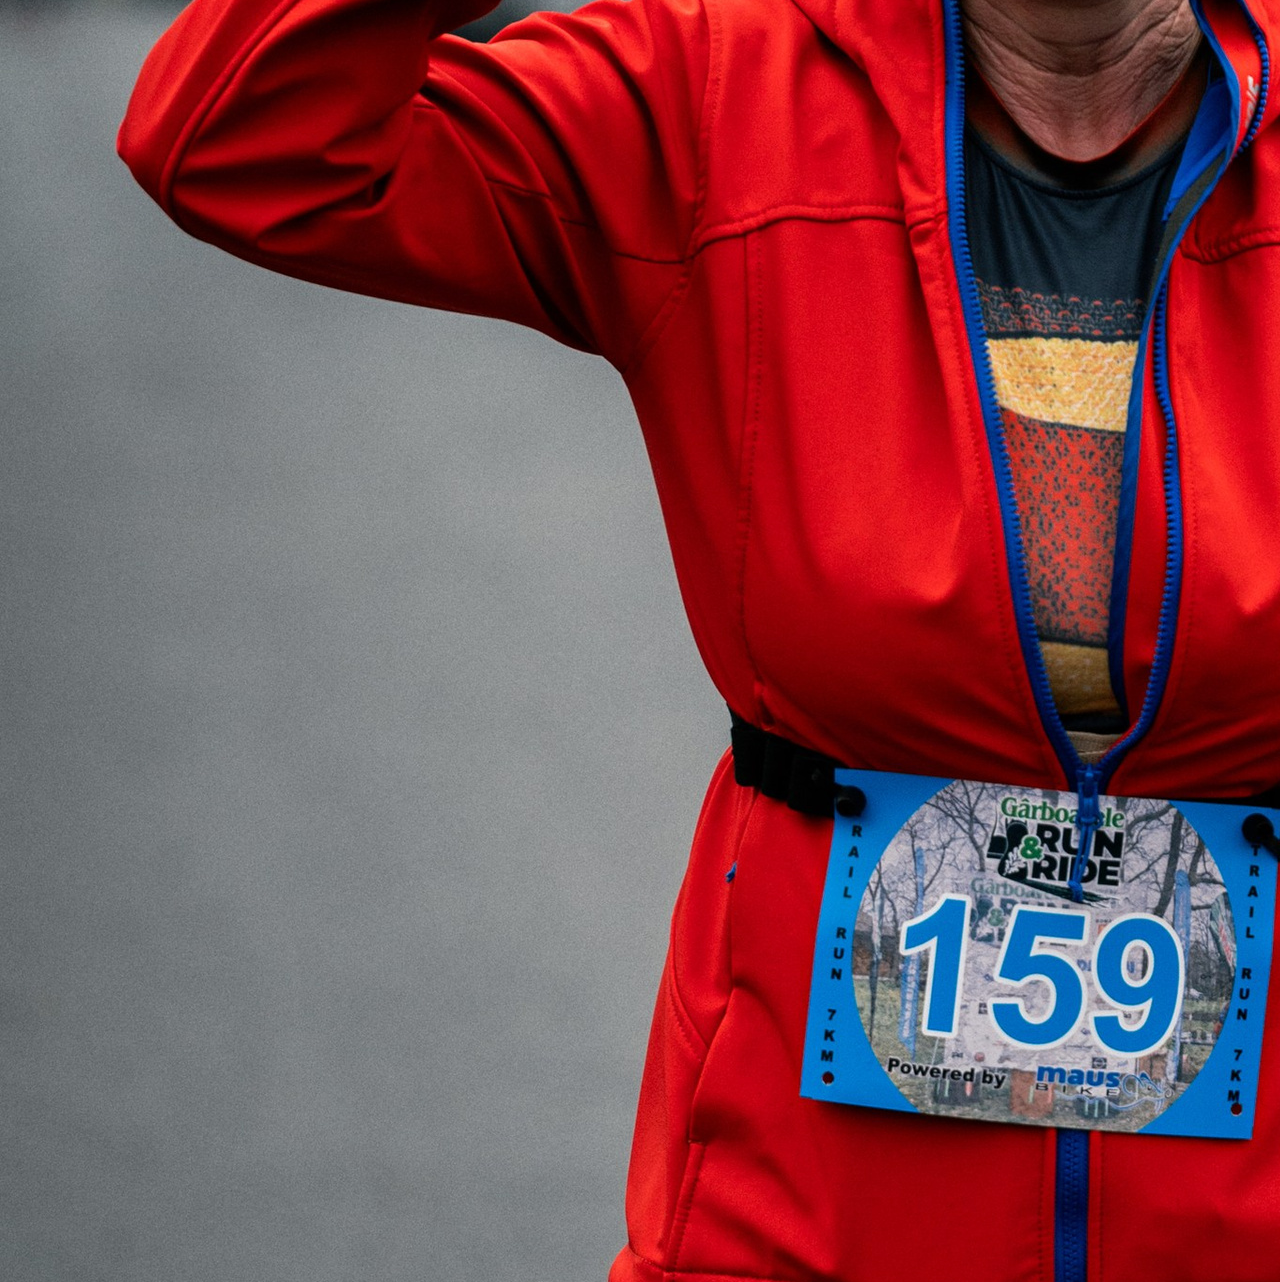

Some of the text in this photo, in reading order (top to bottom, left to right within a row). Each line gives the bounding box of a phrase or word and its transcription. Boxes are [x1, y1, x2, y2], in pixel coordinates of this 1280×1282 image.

[1001, 796, 1125, 828] Gârboale
[1036, 822, 1124, 859] RUN
[843, 824, 862, 898] RAIL
[1031, 854, 1120, 886] RIDE
[1246, 844, 1261, 939] TRAIL
[831, 927, 847, 980] RUN
[902, 896, 1182, 1056] 159
[1237, 968, 1252, 1021] RUN
[887, 1058, 1007, 1089] Powered by
[1035, 1082, 1121, 1097] BIKE
[1036, 1065, 1121, 1088] maus
